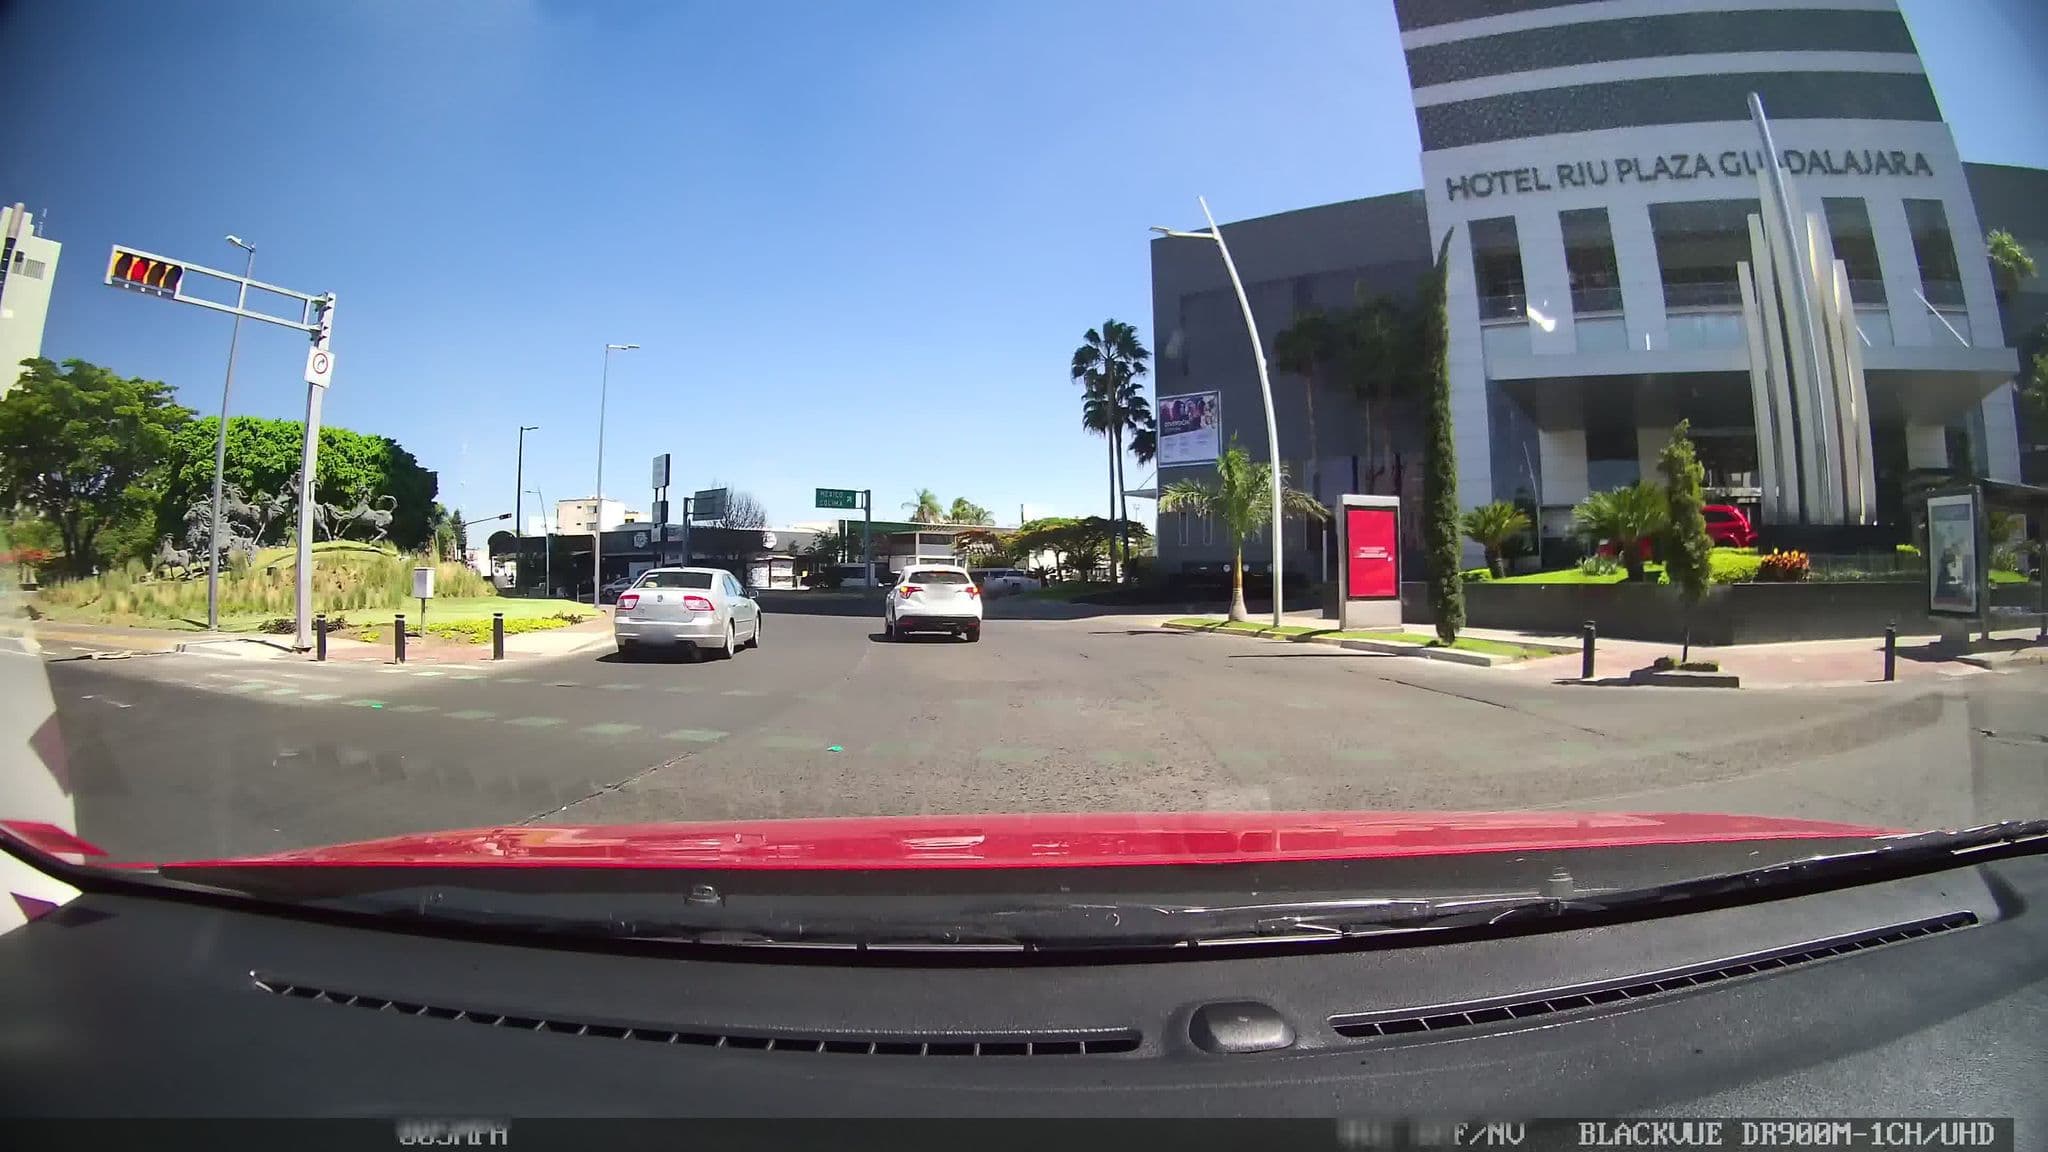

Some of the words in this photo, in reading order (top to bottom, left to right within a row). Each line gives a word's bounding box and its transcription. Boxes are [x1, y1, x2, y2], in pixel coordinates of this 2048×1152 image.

[1446, 167, 1551, 201] HOTEL
[1556, 160, 1609, 189] RIU
[1615, 152, 1715, 183] PLAZA
[1718, 149, 1934, 178] GUDALAJARA
